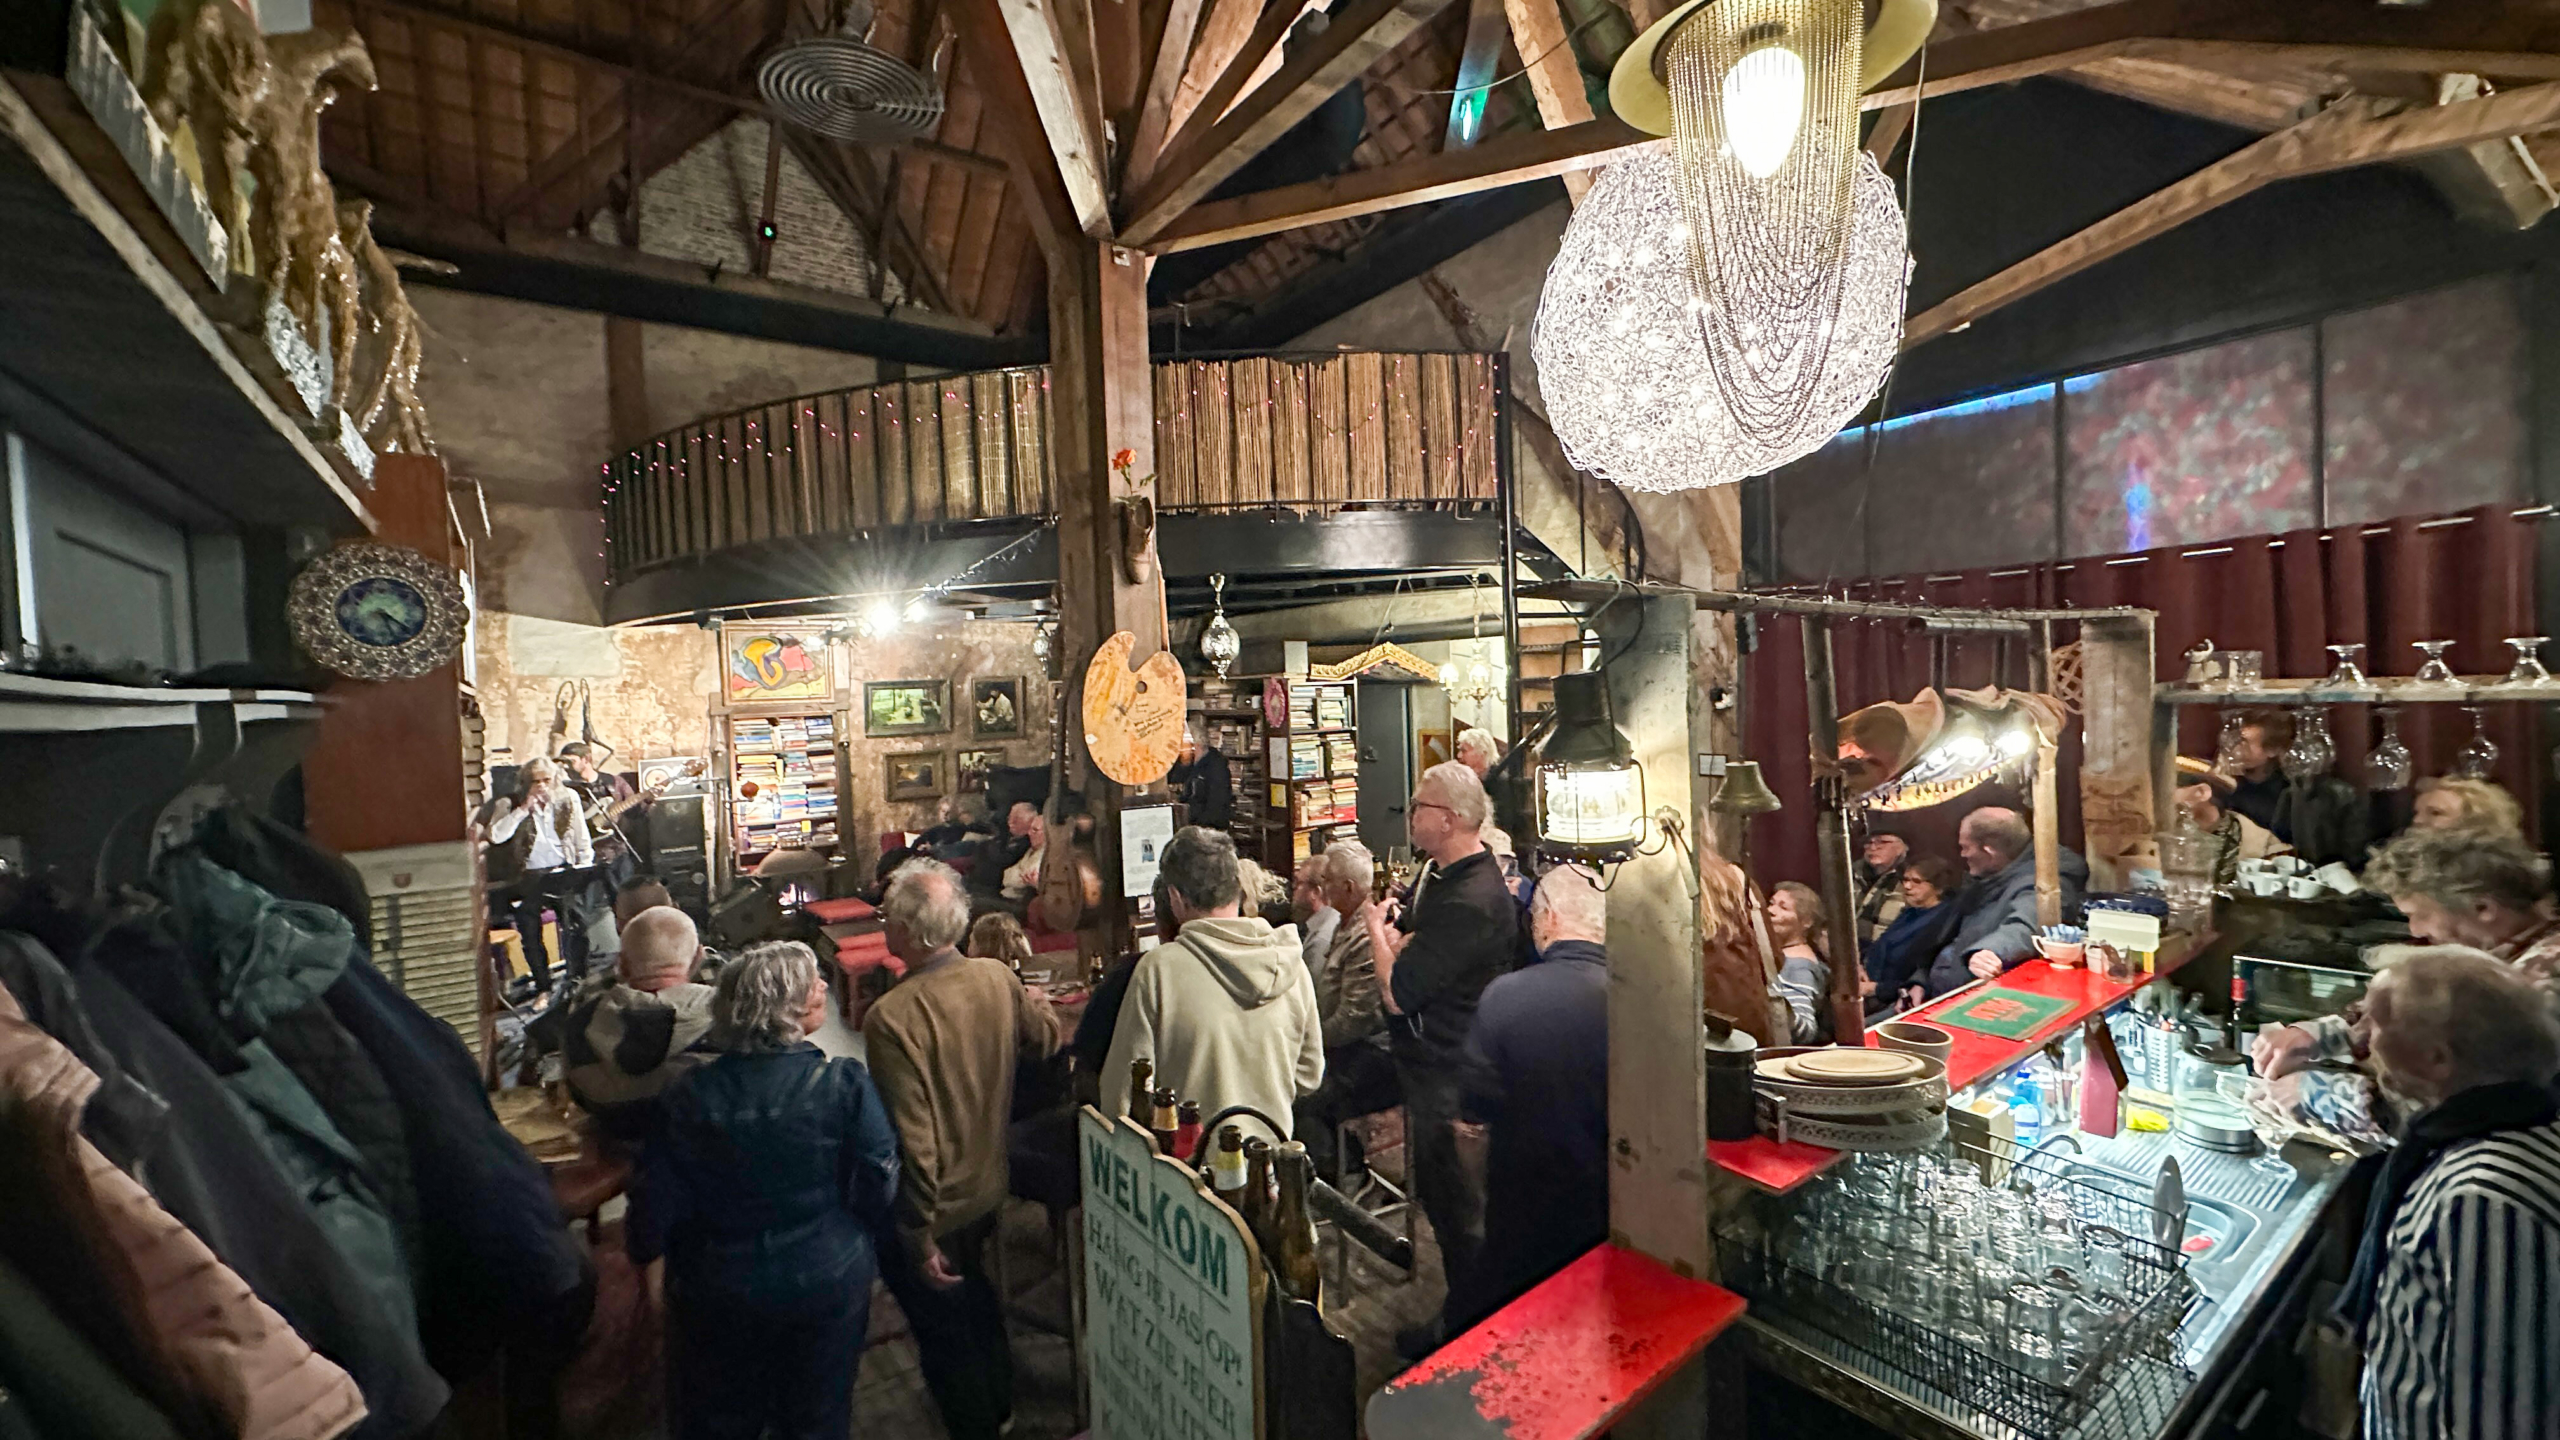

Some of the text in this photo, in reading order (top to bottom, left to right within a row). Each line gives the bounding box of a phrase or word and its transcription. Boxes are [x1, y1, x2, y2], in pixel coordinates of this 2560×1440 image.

[1088, 1133, 1228, 1298] WELKOM
[1089, 1213, 1142, 1287] HANG
[1205, 1328, 1243, 1387] OP!
[1094, 1261, 1141, 1336] WAT
